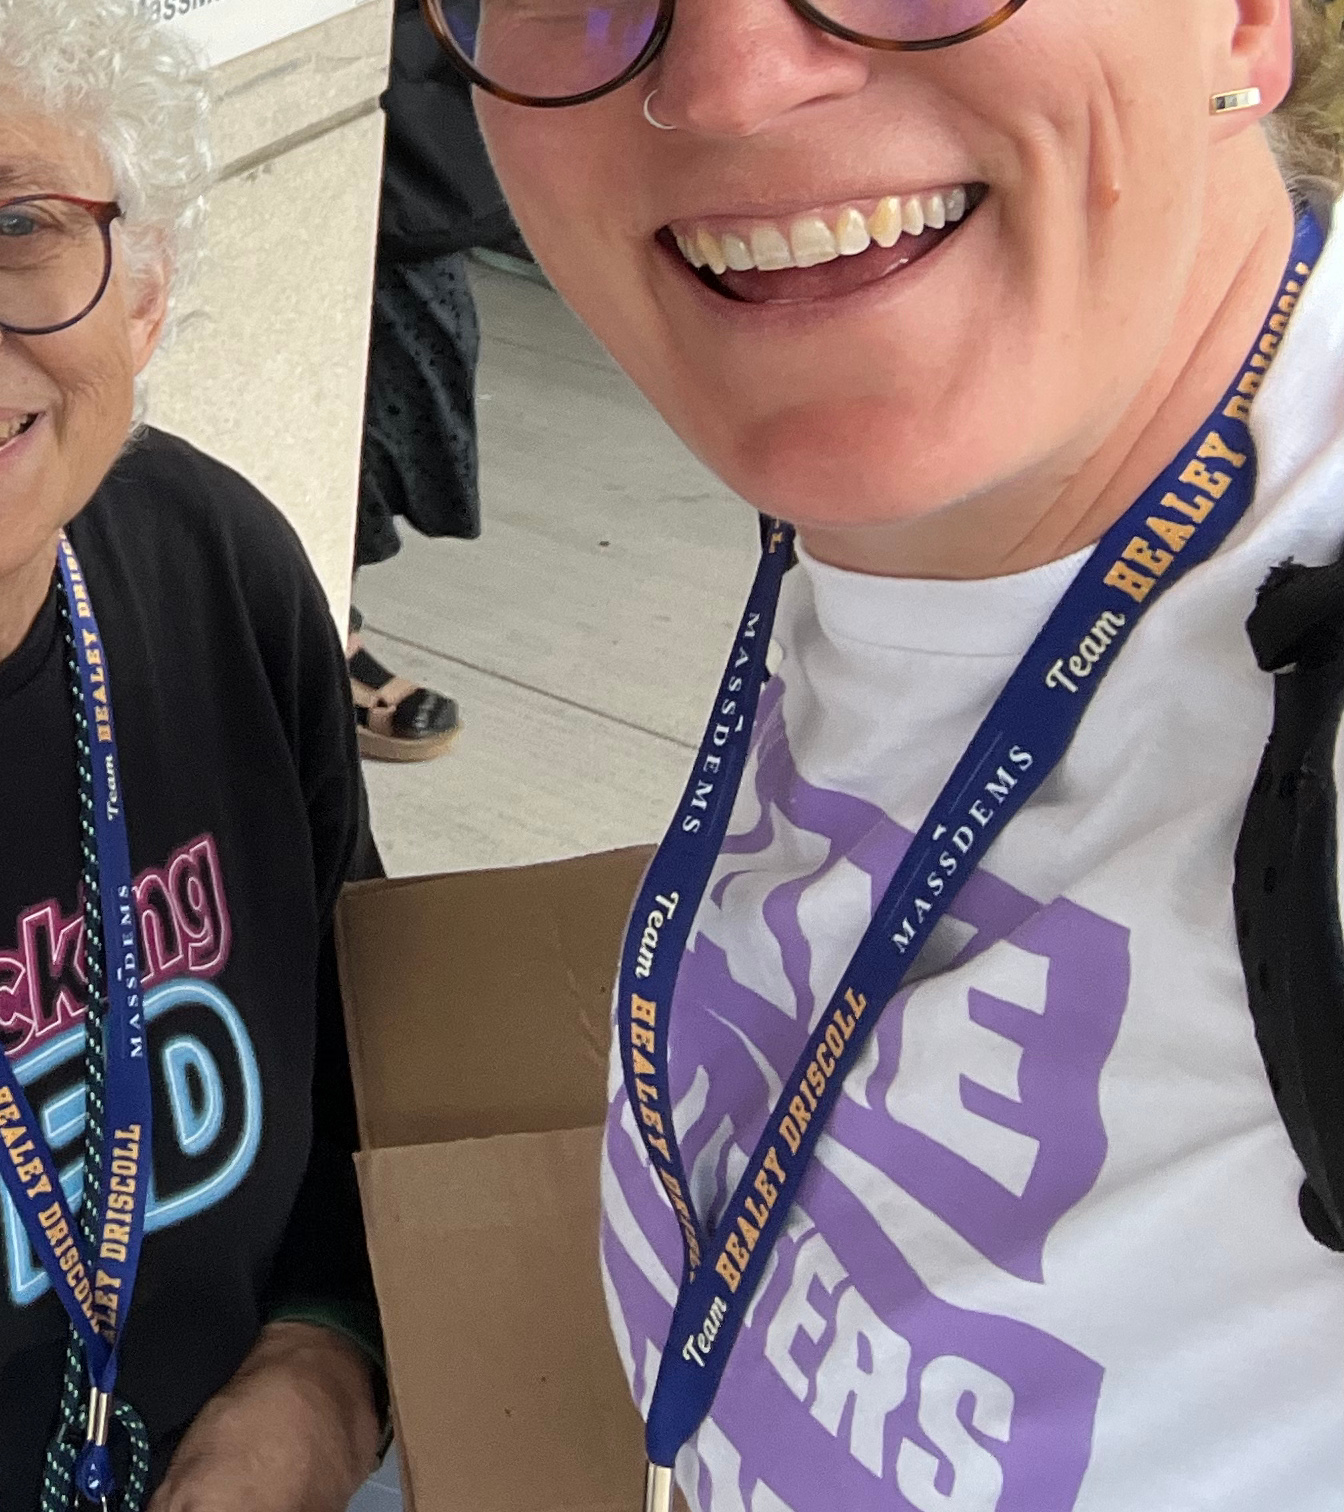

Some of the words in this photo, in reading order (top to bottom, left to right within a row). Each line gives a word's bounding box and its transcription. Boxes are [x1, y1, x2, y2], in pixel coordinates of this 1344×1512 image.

[1045, 609, 1126, 694] Team
[1103, 430, 1248, 605] HEALEY
[79, 628, 113, 743] HEALEY
[681, 611, 761, 834] MASSDEMS
[105, 754, 120, 822] Team
[891, 742, 1035, 956] MASSDEMS
[117, 884, 144, 1060] MASSDEMS
[634, 890, 680, 979] Team
[630, 993, 671, 1164] HEALEY
[99, 1123, 141, 1263] DRISCOLL
[681, 1294, 728, 1368] Team
[715, 1146, 788, 1294] HEALEY
[778, 984, 869, 1157] DRISCOLL
